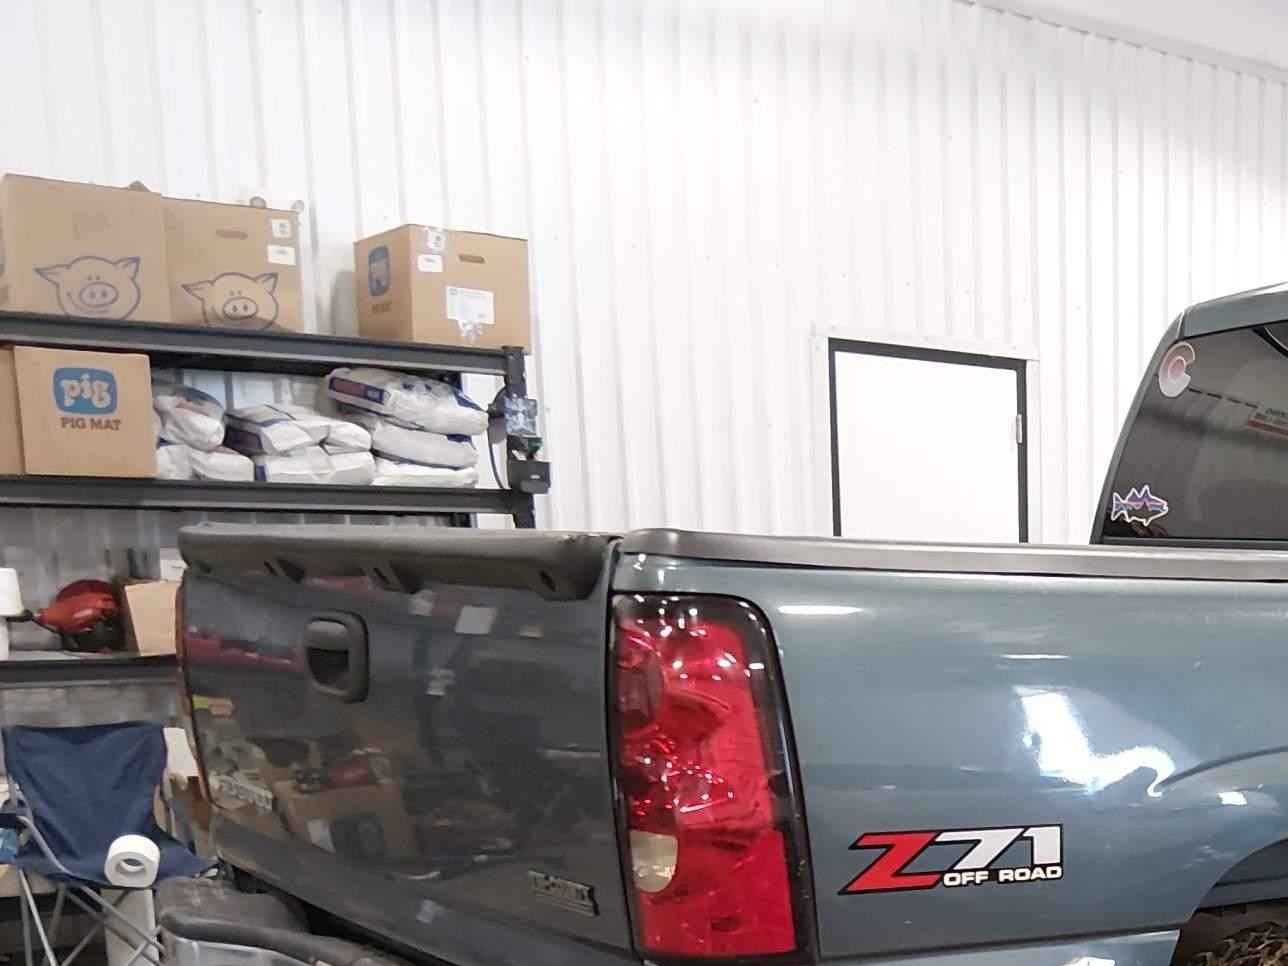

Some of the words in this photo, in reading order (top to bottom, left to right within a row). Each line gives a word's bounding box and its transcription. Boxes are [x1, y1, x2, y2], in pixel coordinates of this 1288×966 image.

[60, 373, 112, 408] pig
[61, 417, 86, 429] PIG
[90, 419, 121, 430] MAT
[838, 824, 1063, 895] Z71
[943, 870, 989, 887] OFF
[998, 865, 1063, 883] ROAD
